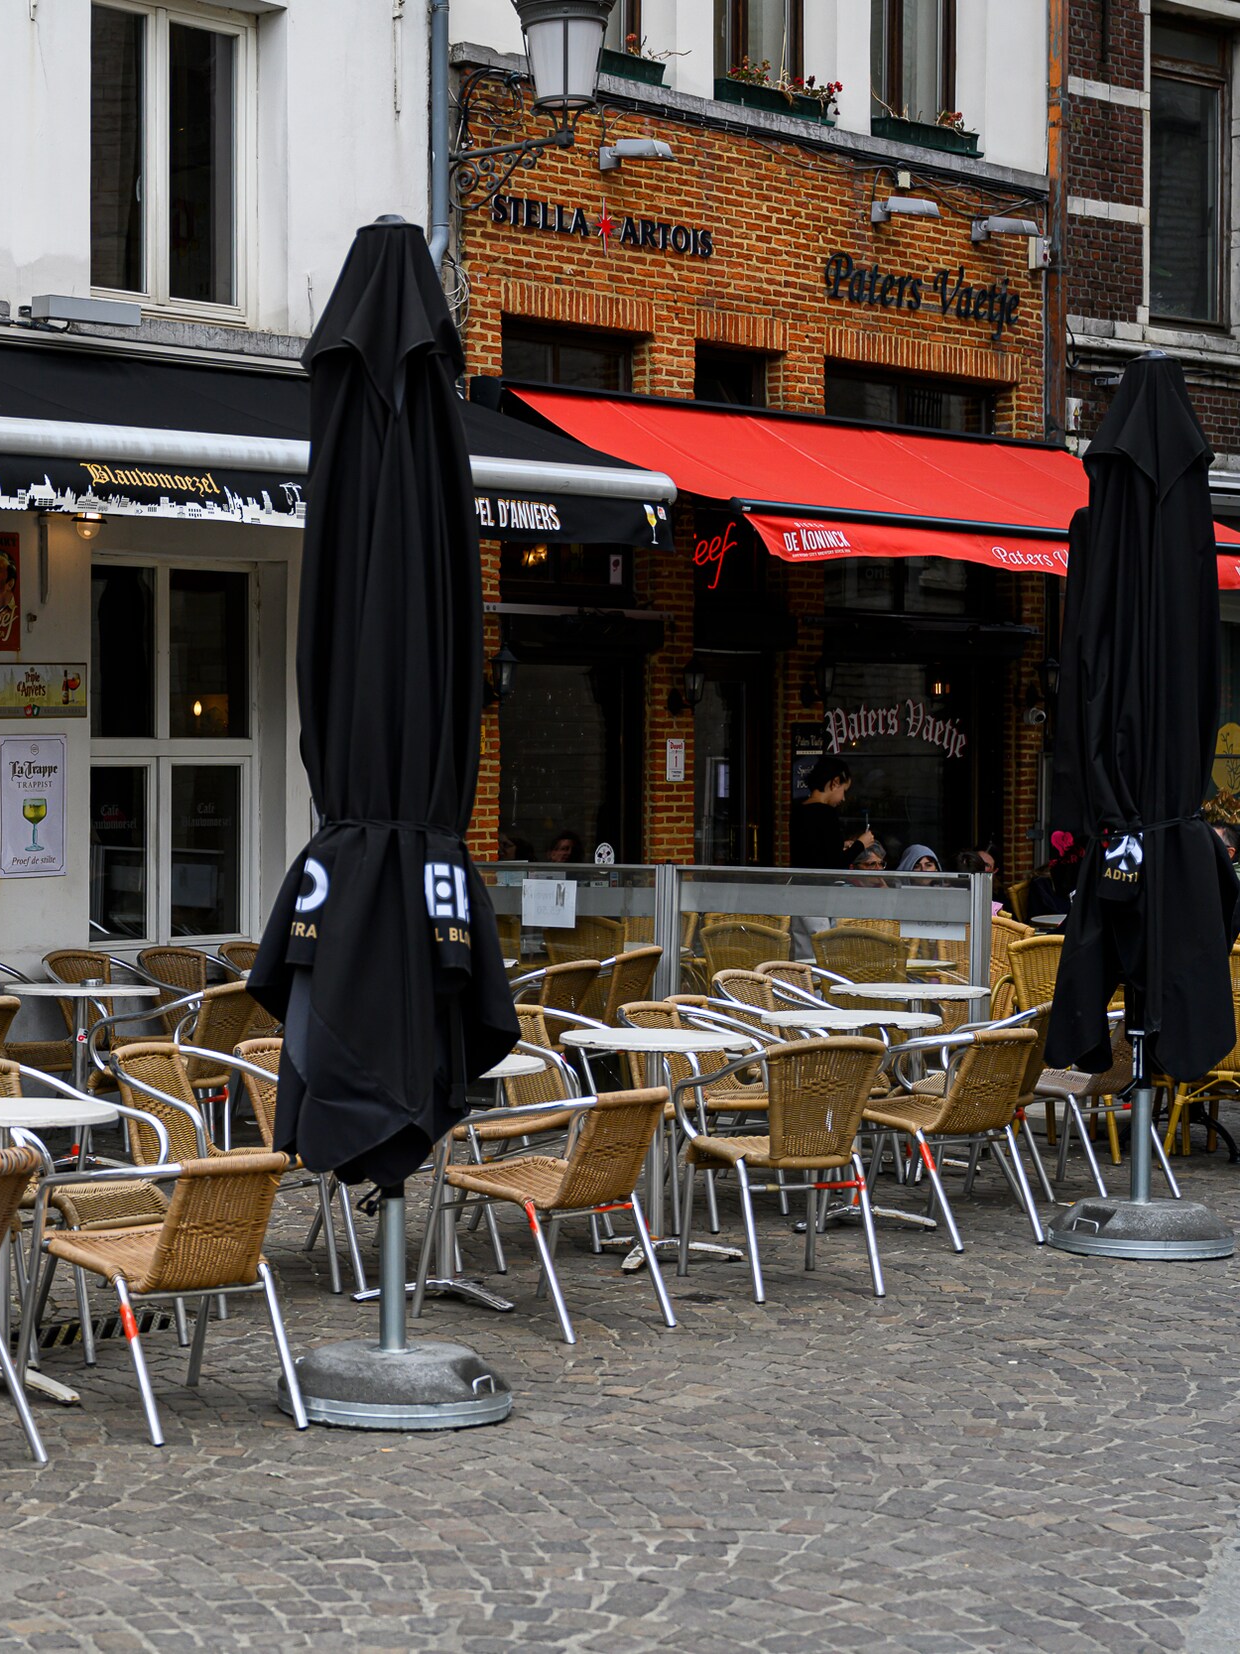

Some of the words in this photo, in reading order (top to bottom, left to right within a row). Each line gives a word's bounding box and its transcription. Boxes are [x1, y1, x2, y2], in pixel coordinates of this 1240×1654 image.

[492, 194, 589, 237] STELLA
[620, 216, 713, 258] ARTOIS
[825, 252, 923, 311] Paters
[932, 265, 1020, 340] Vaetje
[80, 463, 221, 498] Blauwmoezel
[498, 498, 561, 531] D'ANVERS
[783, 531, 800, 552] DE
[800, 528, 851, 551] KONINCK
[692, 521, 738, 589] eef
[991, 546, 1054, 568] Paters
[17, 681, 46, 698] d'Anvers
[825, 703, 900, 754] Paters
[905, 698, 967, 759] Vaetje
[9, 760, 23, 782] La
[23, 760, 58, 780] Trappe
[17, 780, 53, 789] TRAPPIST
[12, 856, 32, 867] Proef
[32, 856, 39, 865] de
